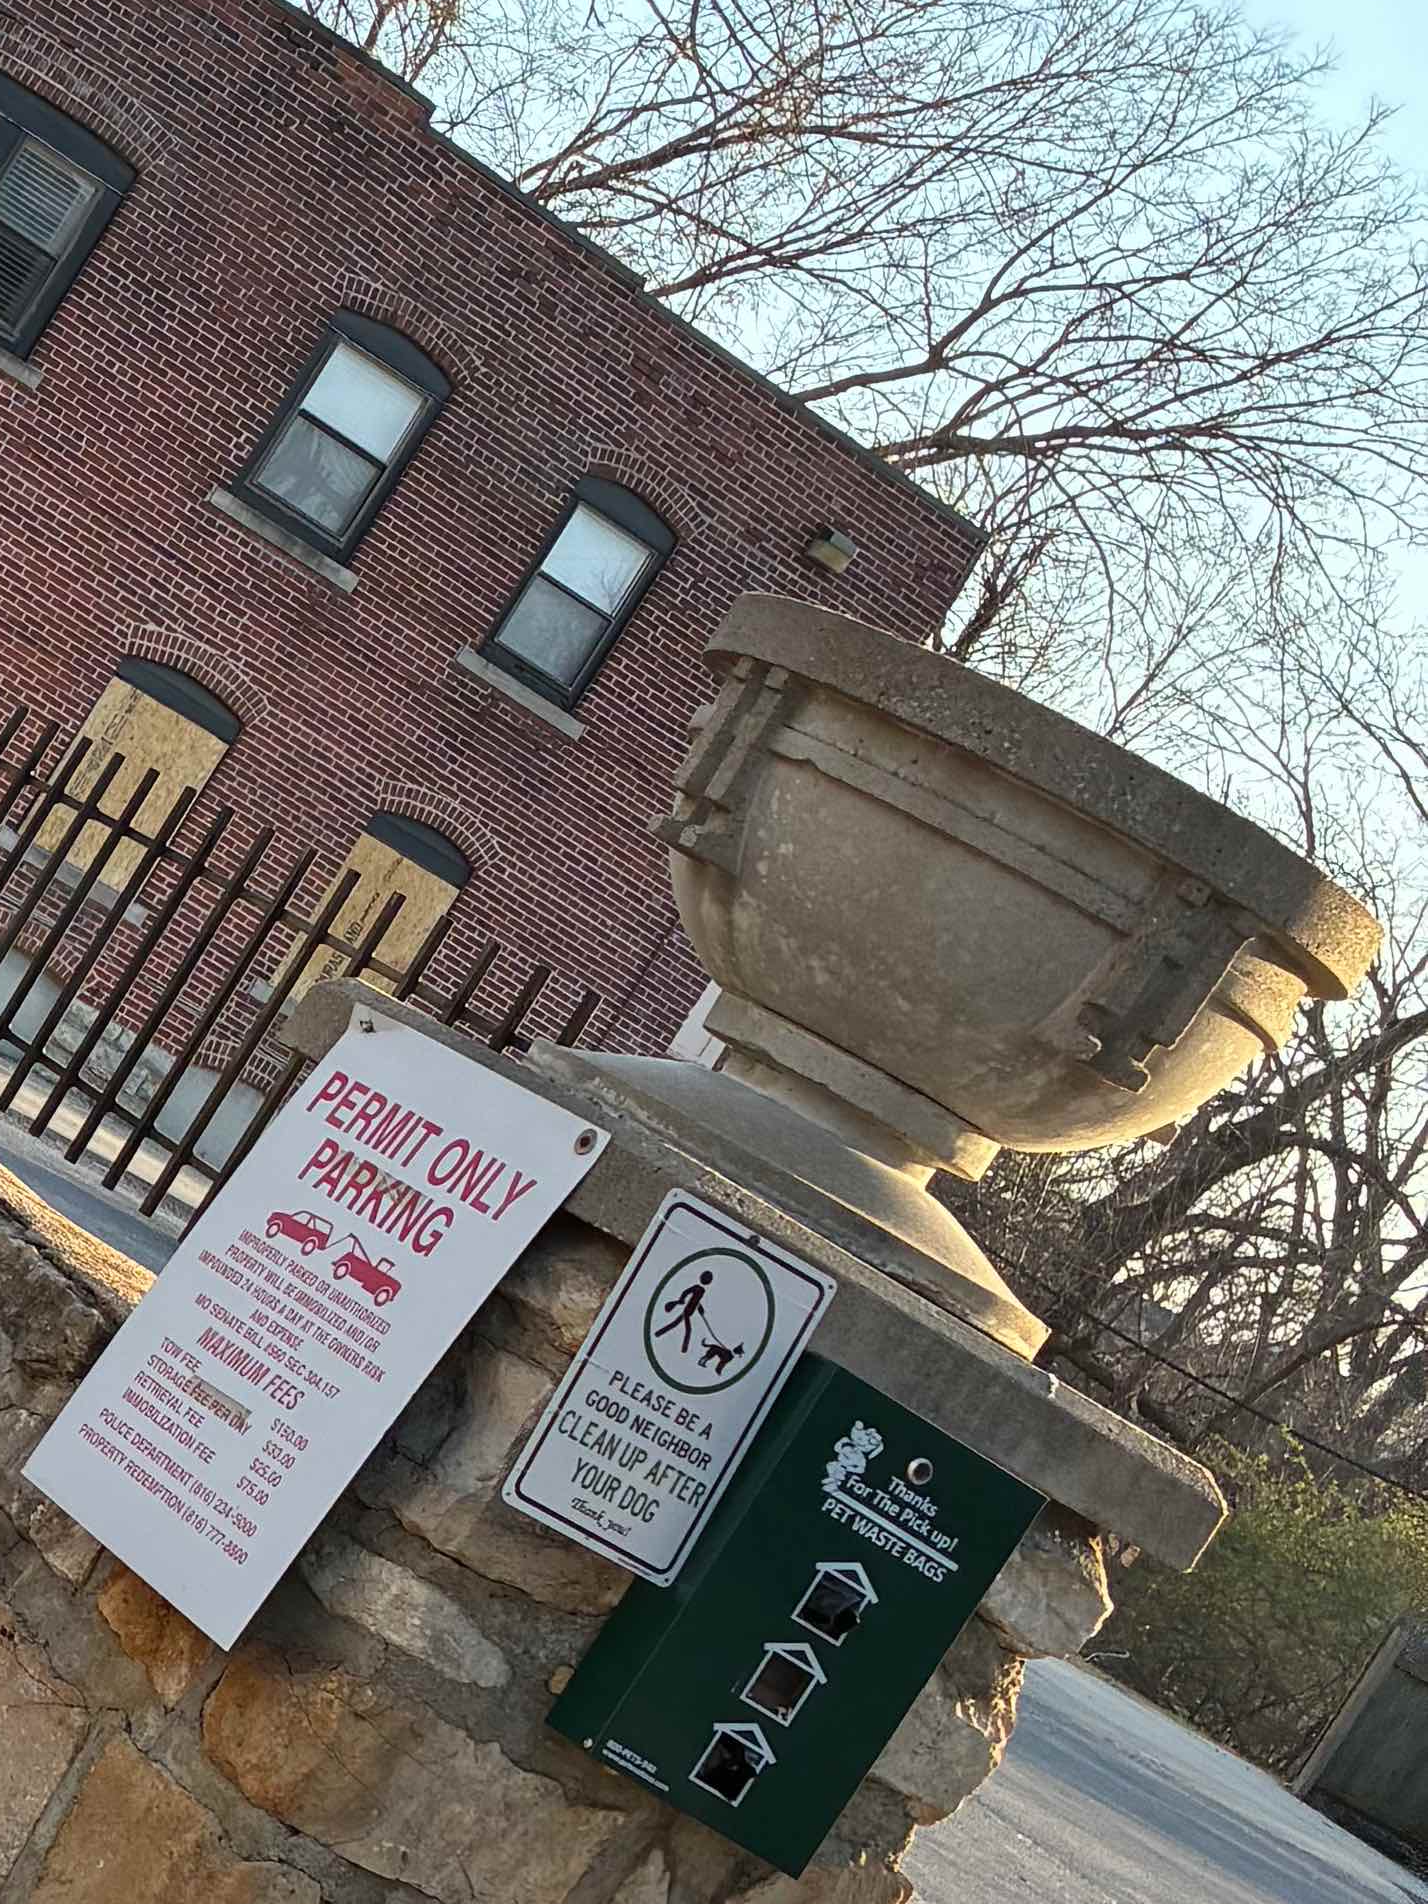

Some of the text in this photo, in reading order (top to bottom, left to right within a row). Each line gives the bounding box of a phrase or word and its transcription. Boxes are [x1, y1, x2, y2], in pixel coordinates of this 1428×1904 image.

[305, 1070, 538, 1222] PERMIT ONLY
[297, 1137, 455, 1258] PARKING
[198, 1250, 386, 1383] IMPOUNDED 24 HOURS A DAY AT THE OWNERS RISK
[225, 1244, 381, 1353] PROPERTY WILL BE IMMOBILIZED AND/OR
[238, 1228, 391, 1335] IMPROPERLY PARKED OR UNAUTHORIZED
[160, 1336, 202, 1373] TOW FEE
[195, 1293, 212, 1310] MO
[209, 1303, 247, 1334] SENATE
[242, 1327, 264, 1349] BILL
[284, 1355, 306, 1376] SEC
[303, 1370, 341, 1399] 304.157
[196, 1327, 305, 1410] MAXIMUM FEES
[249, 1309, 304, 1351] AND EXPENSE
[122, 1386, 216, 1464] IMMOBILIZATION FEE
[134, 1370, 205, 1429] RETRIEVAL FEE
[147, 1354, 252, 1436] STORAGE FEE PER DAY
[585, 1390, 712, 1471] GOOD NEIGHBOR
[608, 1370, 713, 1440] PLEASE BE A
[78, 1423, 128, 1466] PROPERTY
[123, 1460, 186, 1514] REDEMPTION
[181, 1506, 208, 1534] (816)
[99, 1408, 135, 1441] POLICE
[130, 1432, 194, 1486] DEPARTMENT
[188, 1479, 217, 1506] (816)
[236, 1476, 269, 1506] $75.00
[249, 1457, 282, 1487] $25.00
[558, 1410, 707, 1509] CLEAN UP AFTER
[571, 1457, 660, 1523] YOUR DOG
[887, 1475, 939, 1518] Thanks
[571, 1497, 632, 1537] Thank you!
[820, 1497, 948, 1583] PET WASTE BAGS
[845, 1474, 960, 1553] For The Pick up!
